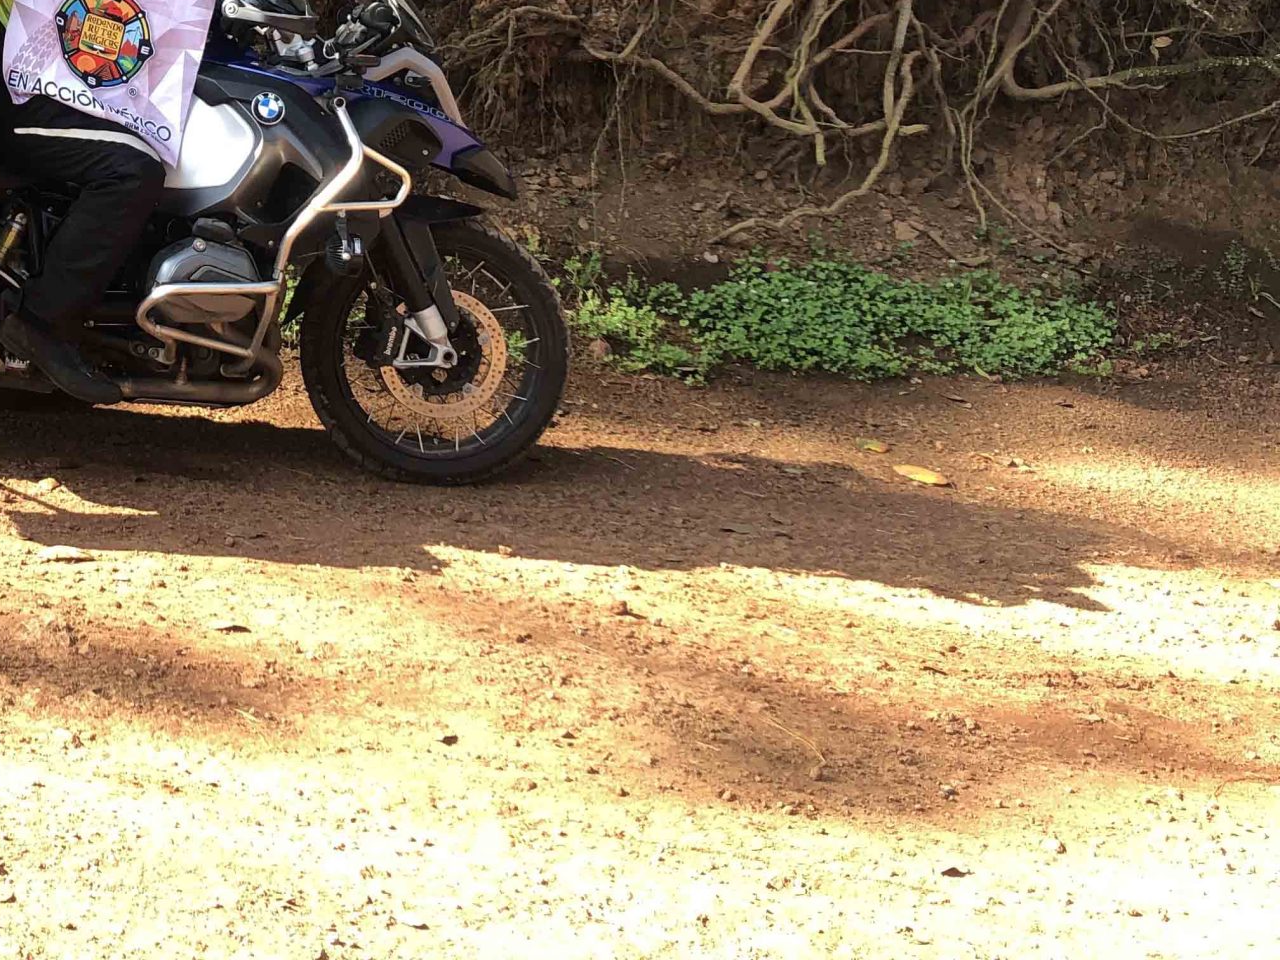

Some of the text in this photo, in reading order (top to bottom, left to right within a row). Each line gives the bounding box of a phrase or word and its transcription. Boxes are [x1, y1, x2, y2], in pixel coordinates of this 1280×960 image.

[140, 46, 150, 54] E
[8, 69, 28, 90] EN
[31, 78, 106, 110] ACCIÓN
